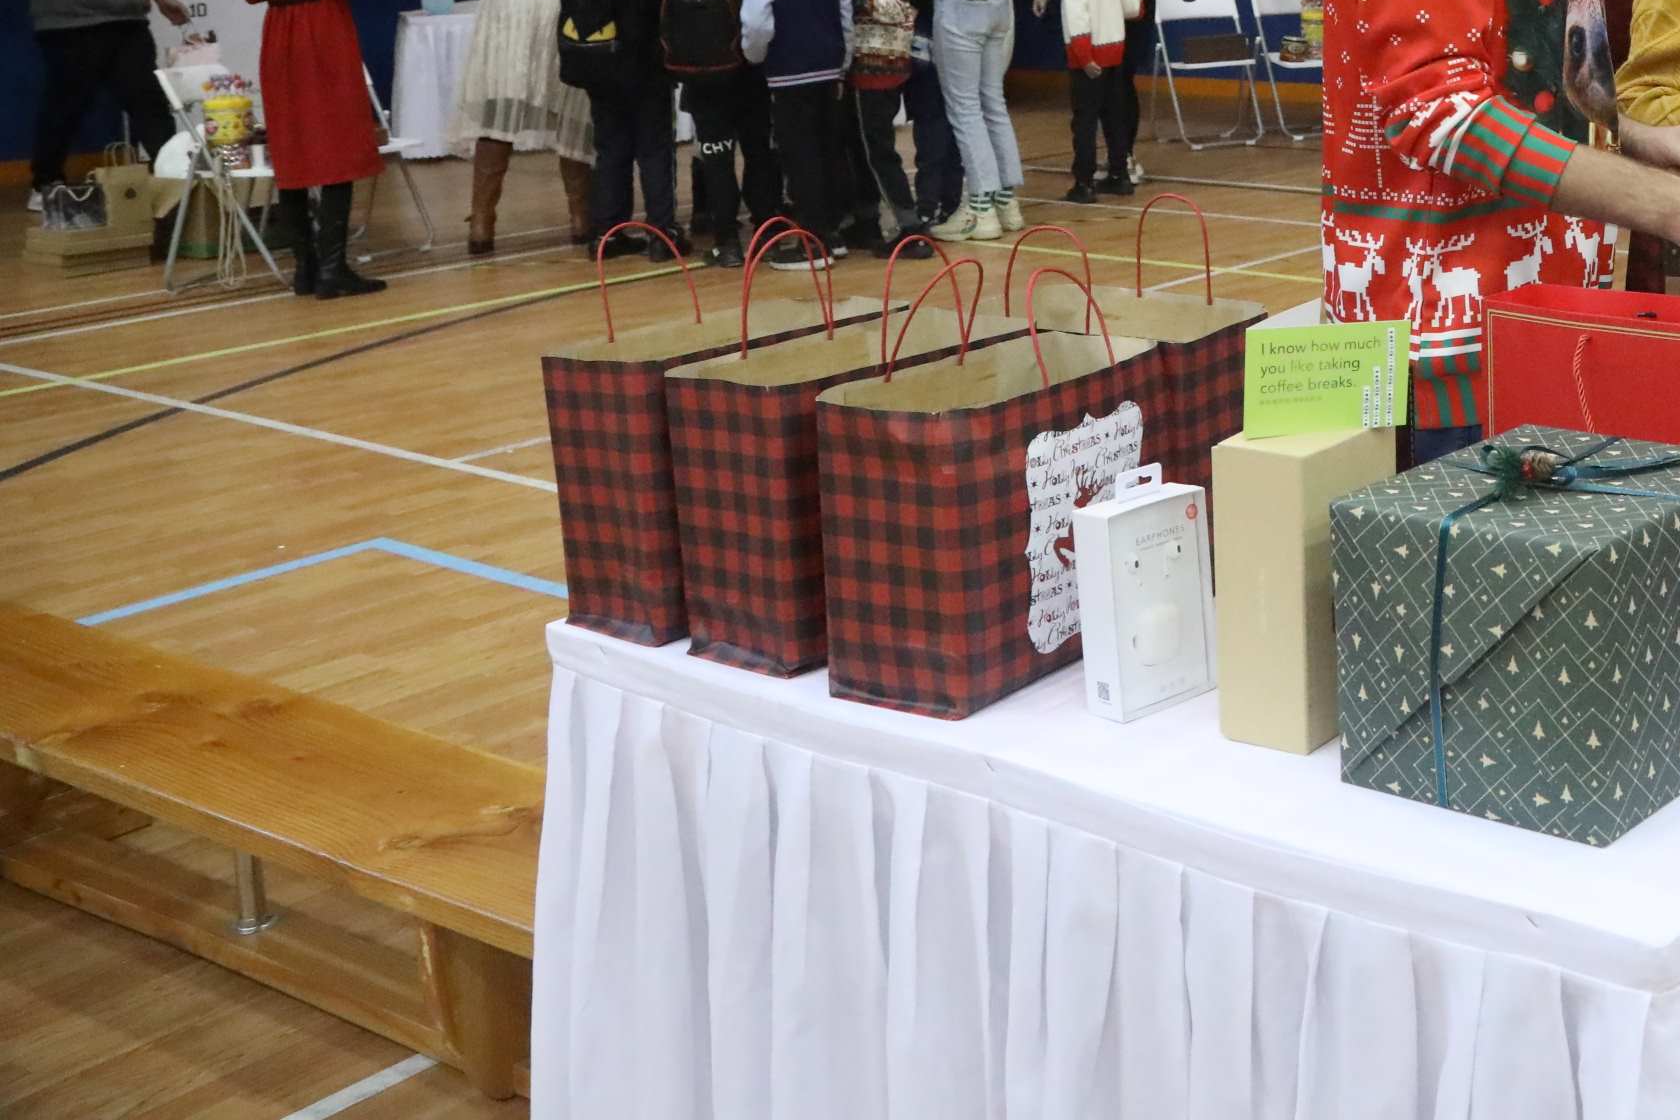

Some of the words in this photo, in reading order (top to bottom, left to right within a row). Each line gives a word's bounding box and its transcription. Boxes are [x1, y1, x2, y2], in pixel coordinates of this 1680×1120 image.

[190, 3, 207, 17] 10
[1270, 342, 1307, 355] know
[1311, 339, 1343, 352] how
[1344, 336, 1381, 351] much
[1260, 364, 1286, 378] you
[1290, 360, 1315, 374] like
[1319, 357, 1361, 372] taking
[1260, 379, 1304, 394] coffee
[1136, 524, 1185, 547] EARPHONES
